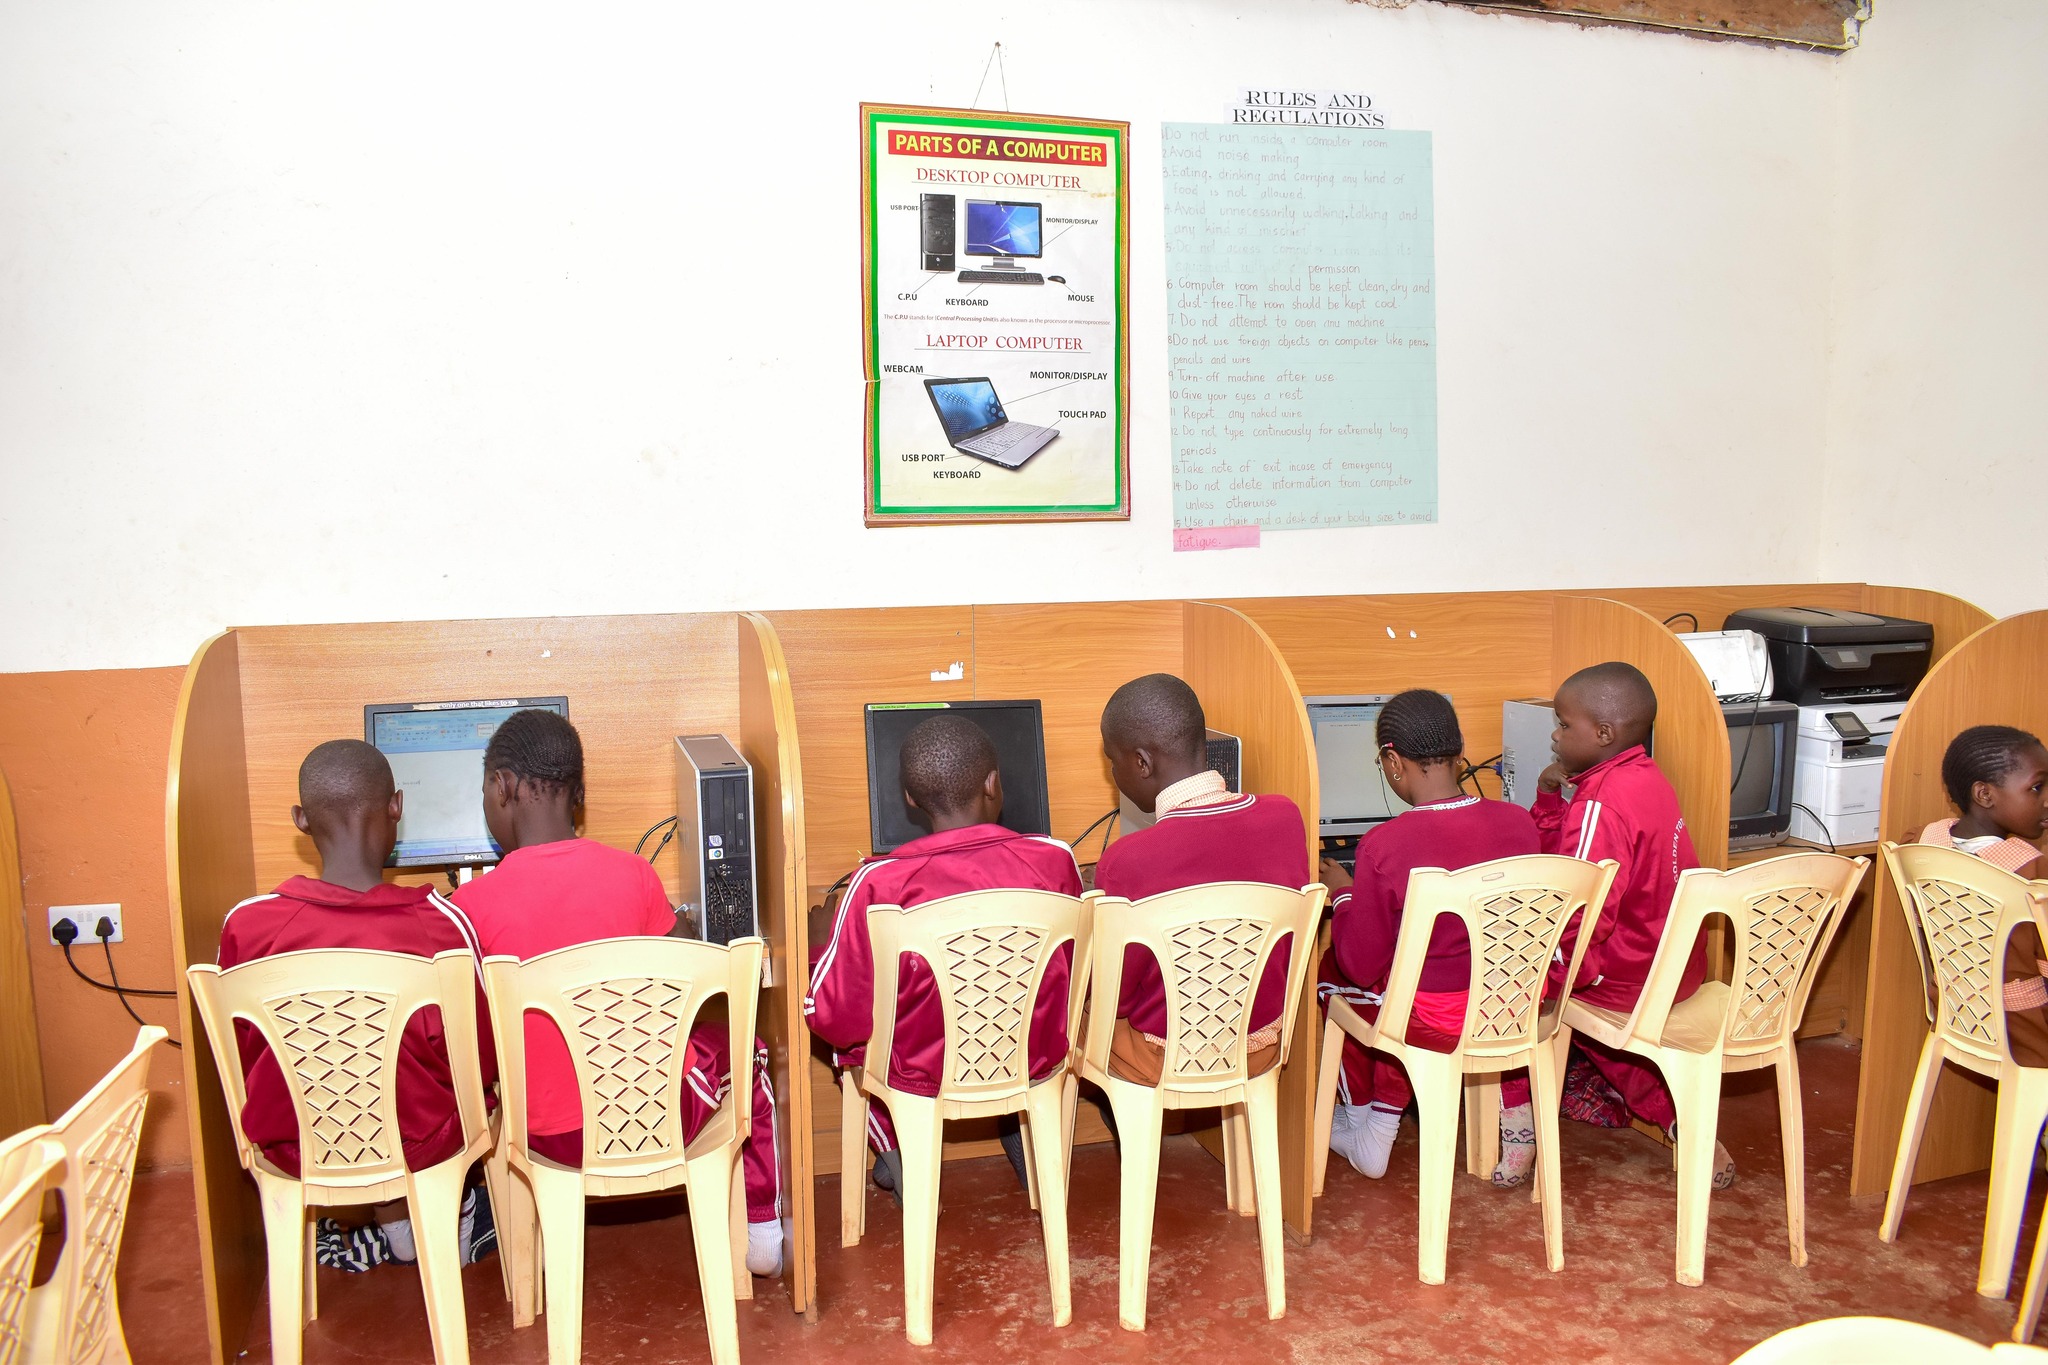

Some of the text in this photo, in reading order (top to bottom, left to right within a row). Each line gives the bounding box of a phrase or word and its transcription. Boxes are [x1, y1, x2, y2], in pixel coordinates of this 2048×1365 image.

[1247, 91, 1372, 109] RULES AND
[1233, 109, 1384, 127] REGULATIONS
[895, 134, 1102, 162] PARTS OF A COMPUTER
[1190, 127, 1210, 141] not
[1219, 132, 1240, 143] run
[1306, 134, 1352, 151] computer
[1362, 139, 1388, 148] room
[1218, 149, 1249, 161] noise
[1261, 149, 1299, 169] making
[916, 168, 1081, 189] DESKTOP COMPUTER
[1218, 168, 1261, 186] drinking
[1268, 169, 1287, 182] and
[1294, 172, 1334, 187] carrying
[1342, 175, 1357, 188] any
[1364, 169, 1385, 184] kind
[1393, 174, 1406, 185] of
[1173, 182, 1198, 196] food
[1210, 189, 1219, 197] is
[1227, 185, 1247, 198] not
[1046, 217, 1098, 225] MONITOR/DISPLAY
[1220, 204, 1295, 225] unnecessarily
[1398, 206, 1418, 221] and
[1174, 225, 1195, 240] any
[1205, 218, 1230, 233] kind
[1308, 265, 1361, 279] permission
[898, 293, 918, 301] C.P.U
[1235, 282, 1258, 291] room
[1268, 276, 1301, 292] should
[1309, 277, 1321, 291] be
[1329, 277, 1351, 298] kept
[1391, 278, 1407, 300] dry
[1413, 278, 1430, 294] and
[945, 298, 989, 307] KEYBOARD
[1068, 294, 1094, 303] MOUSE
[1263, 301, 1284, 309] room
[1292, 295, 1321, 309] should
[1328, 296, 1339, 309] be
[1345, 294, 1366, 314] kept
[1180, 312, 1196, 327] Do
[1202, 313, 1218, 327] not
[1229, 313, 1267, 328] attempt
[1275, 315, 1287, 328] to
[1347, 314, 1384, 328] machine
[926, 334, 1083, 351] LAPTOP COMPUTER
[1192, 334, 1208, 346] not
[1214, 338, 1229, 346] use
[1238, 334, 1270, 350] foreign
[1278, 333, 1310, 349] objects
[1334, 336, 1378, 349] computer
[1385, 332, 1403, 346] like
[883, 365, 924, 373] WEBCAM
[1173, 351, 1251, 369] pencils and wire
[1029, 371, 1108, 380] MONITOR/DISPLAY
[1228, 370, 1265, 383] machine
[1276, 368, 1306, 382] after
[1207, 393, 1227, 405] your
[1235, 392, 1256, 405] eyes
[1264, 392, 1271, 400] a
[1279, 387, 1304, 400] rest
[1058, 410, 1107, 419] TOUCH PAD
[1183, 405, 1302, 424] Report any naked wire
[1182, 421, 1408, 443] Do not type continuously for extremely long
[902, 454, 945, 462] USB PORT
[1181, 441, 1217, 461] periods
[933, 471, 981, 479] KEYBOARD
[1211, 459, 1232, 474] note
[1240, 459, 1251, 472] of
[1263, 459, 1281, 472] exit
[1289, 460, 1315, 472] incase
[1322, 457, 1332, 471] of
[1341, 460, 1392, 475] emergency
[1185, 474, 1412, 491] Do not delete information from computer
[1185, 495, 1277, 510] unless otherwise
[1184, 515, 1203, 527] Use
[1223, 513, 1246, 527] chair
[1254, 510, 1271, 526] and
[1275, 515, 1281, 525] a
[1286, 511, 1306, 525] desk
[1310, 511, 1319, 524] of
[1324, 514, 1342, 527] your
[1347, 508, 1370, 527] body
[1376, 512, 1394, 523] size
[1397, 510, 1406, 520] to
[1410, 508, 1432, 522] avoid
[1177, 534, 1222, 551] fatigue.
